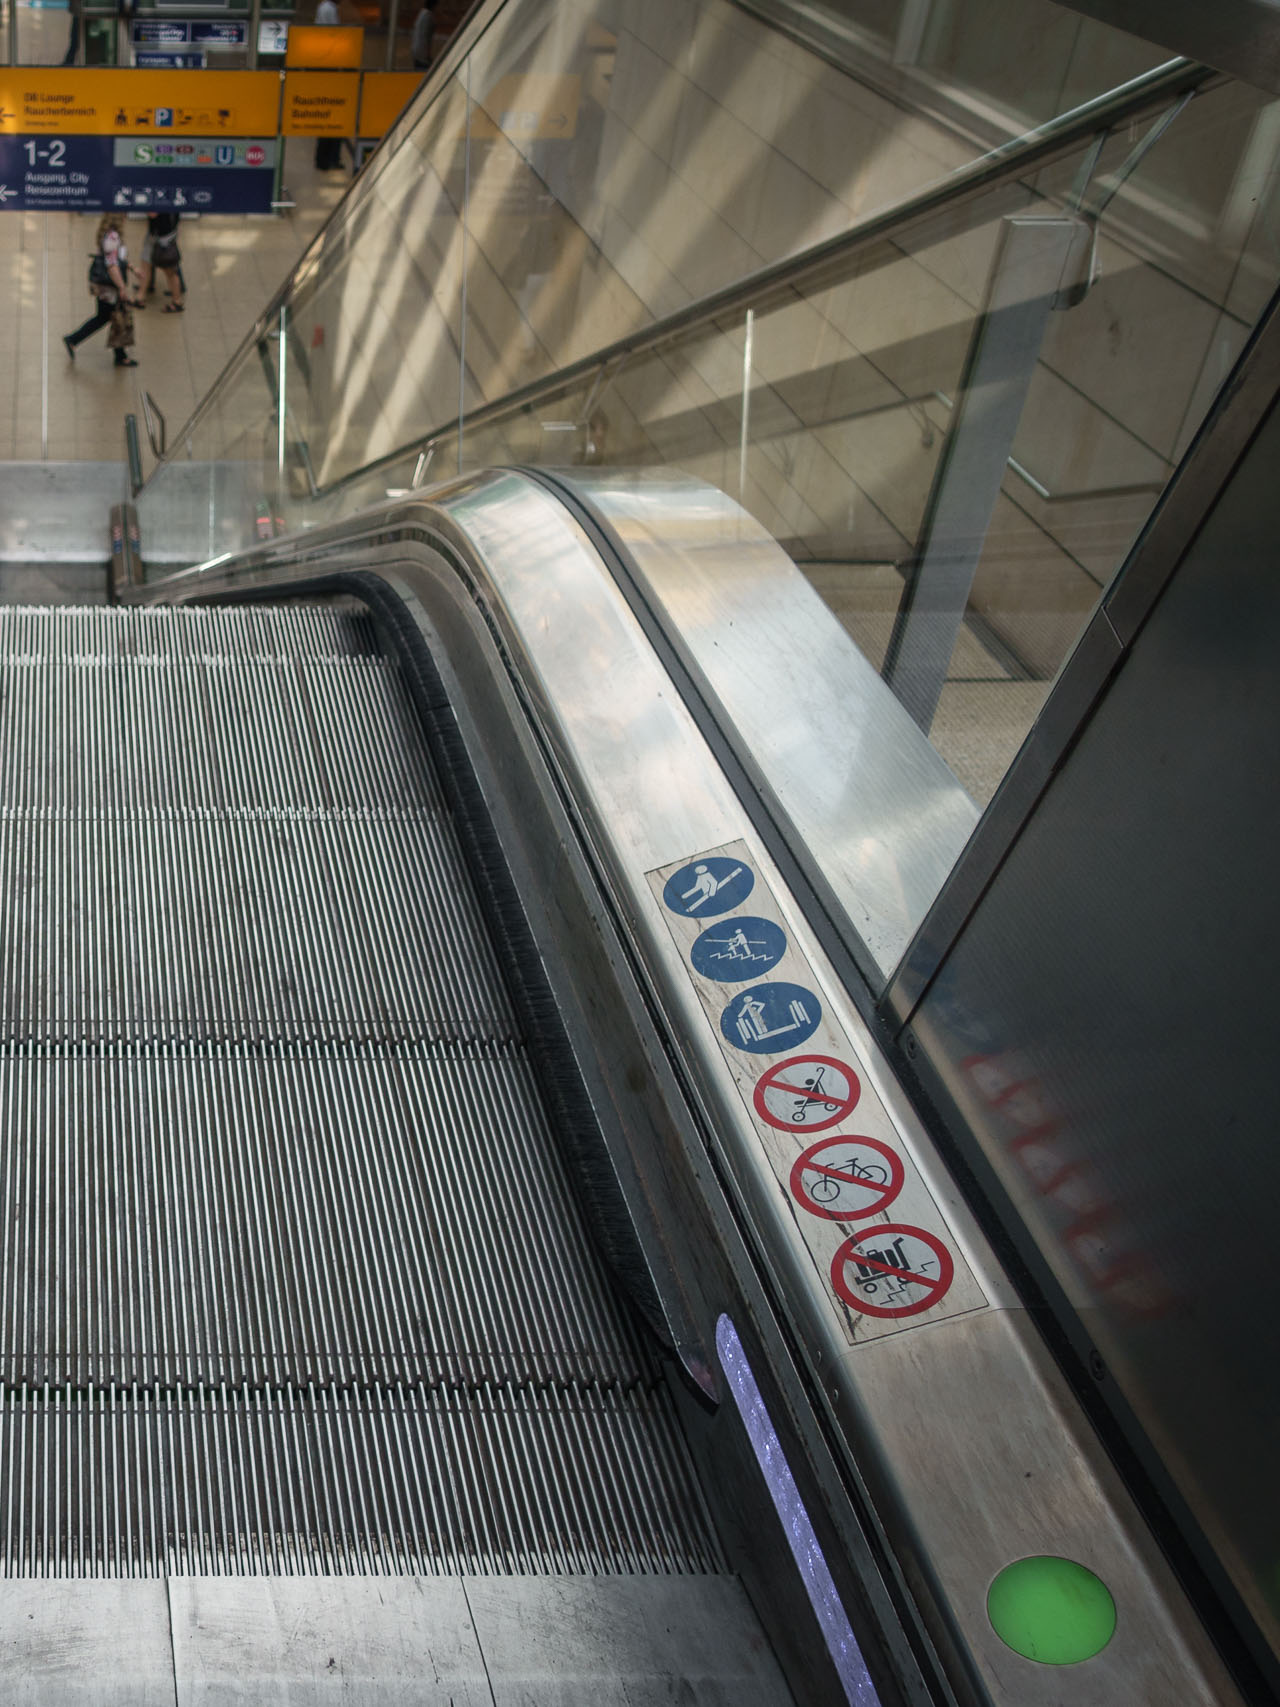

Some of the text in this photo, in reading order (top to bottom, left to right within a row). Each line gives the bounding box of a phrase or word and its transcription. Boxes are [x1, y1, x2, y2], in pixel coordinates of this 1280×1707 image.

[40, 94, 75, 104] Lounge
[156, 108, 169, 126] P
[291, 109, 331, 119] Bahnhof
[24, 140, 66, 166] 1-2
[136, 146, 151, 162] S
[218, 146, 233, 163] U
[69, 173, 89, 184] City
